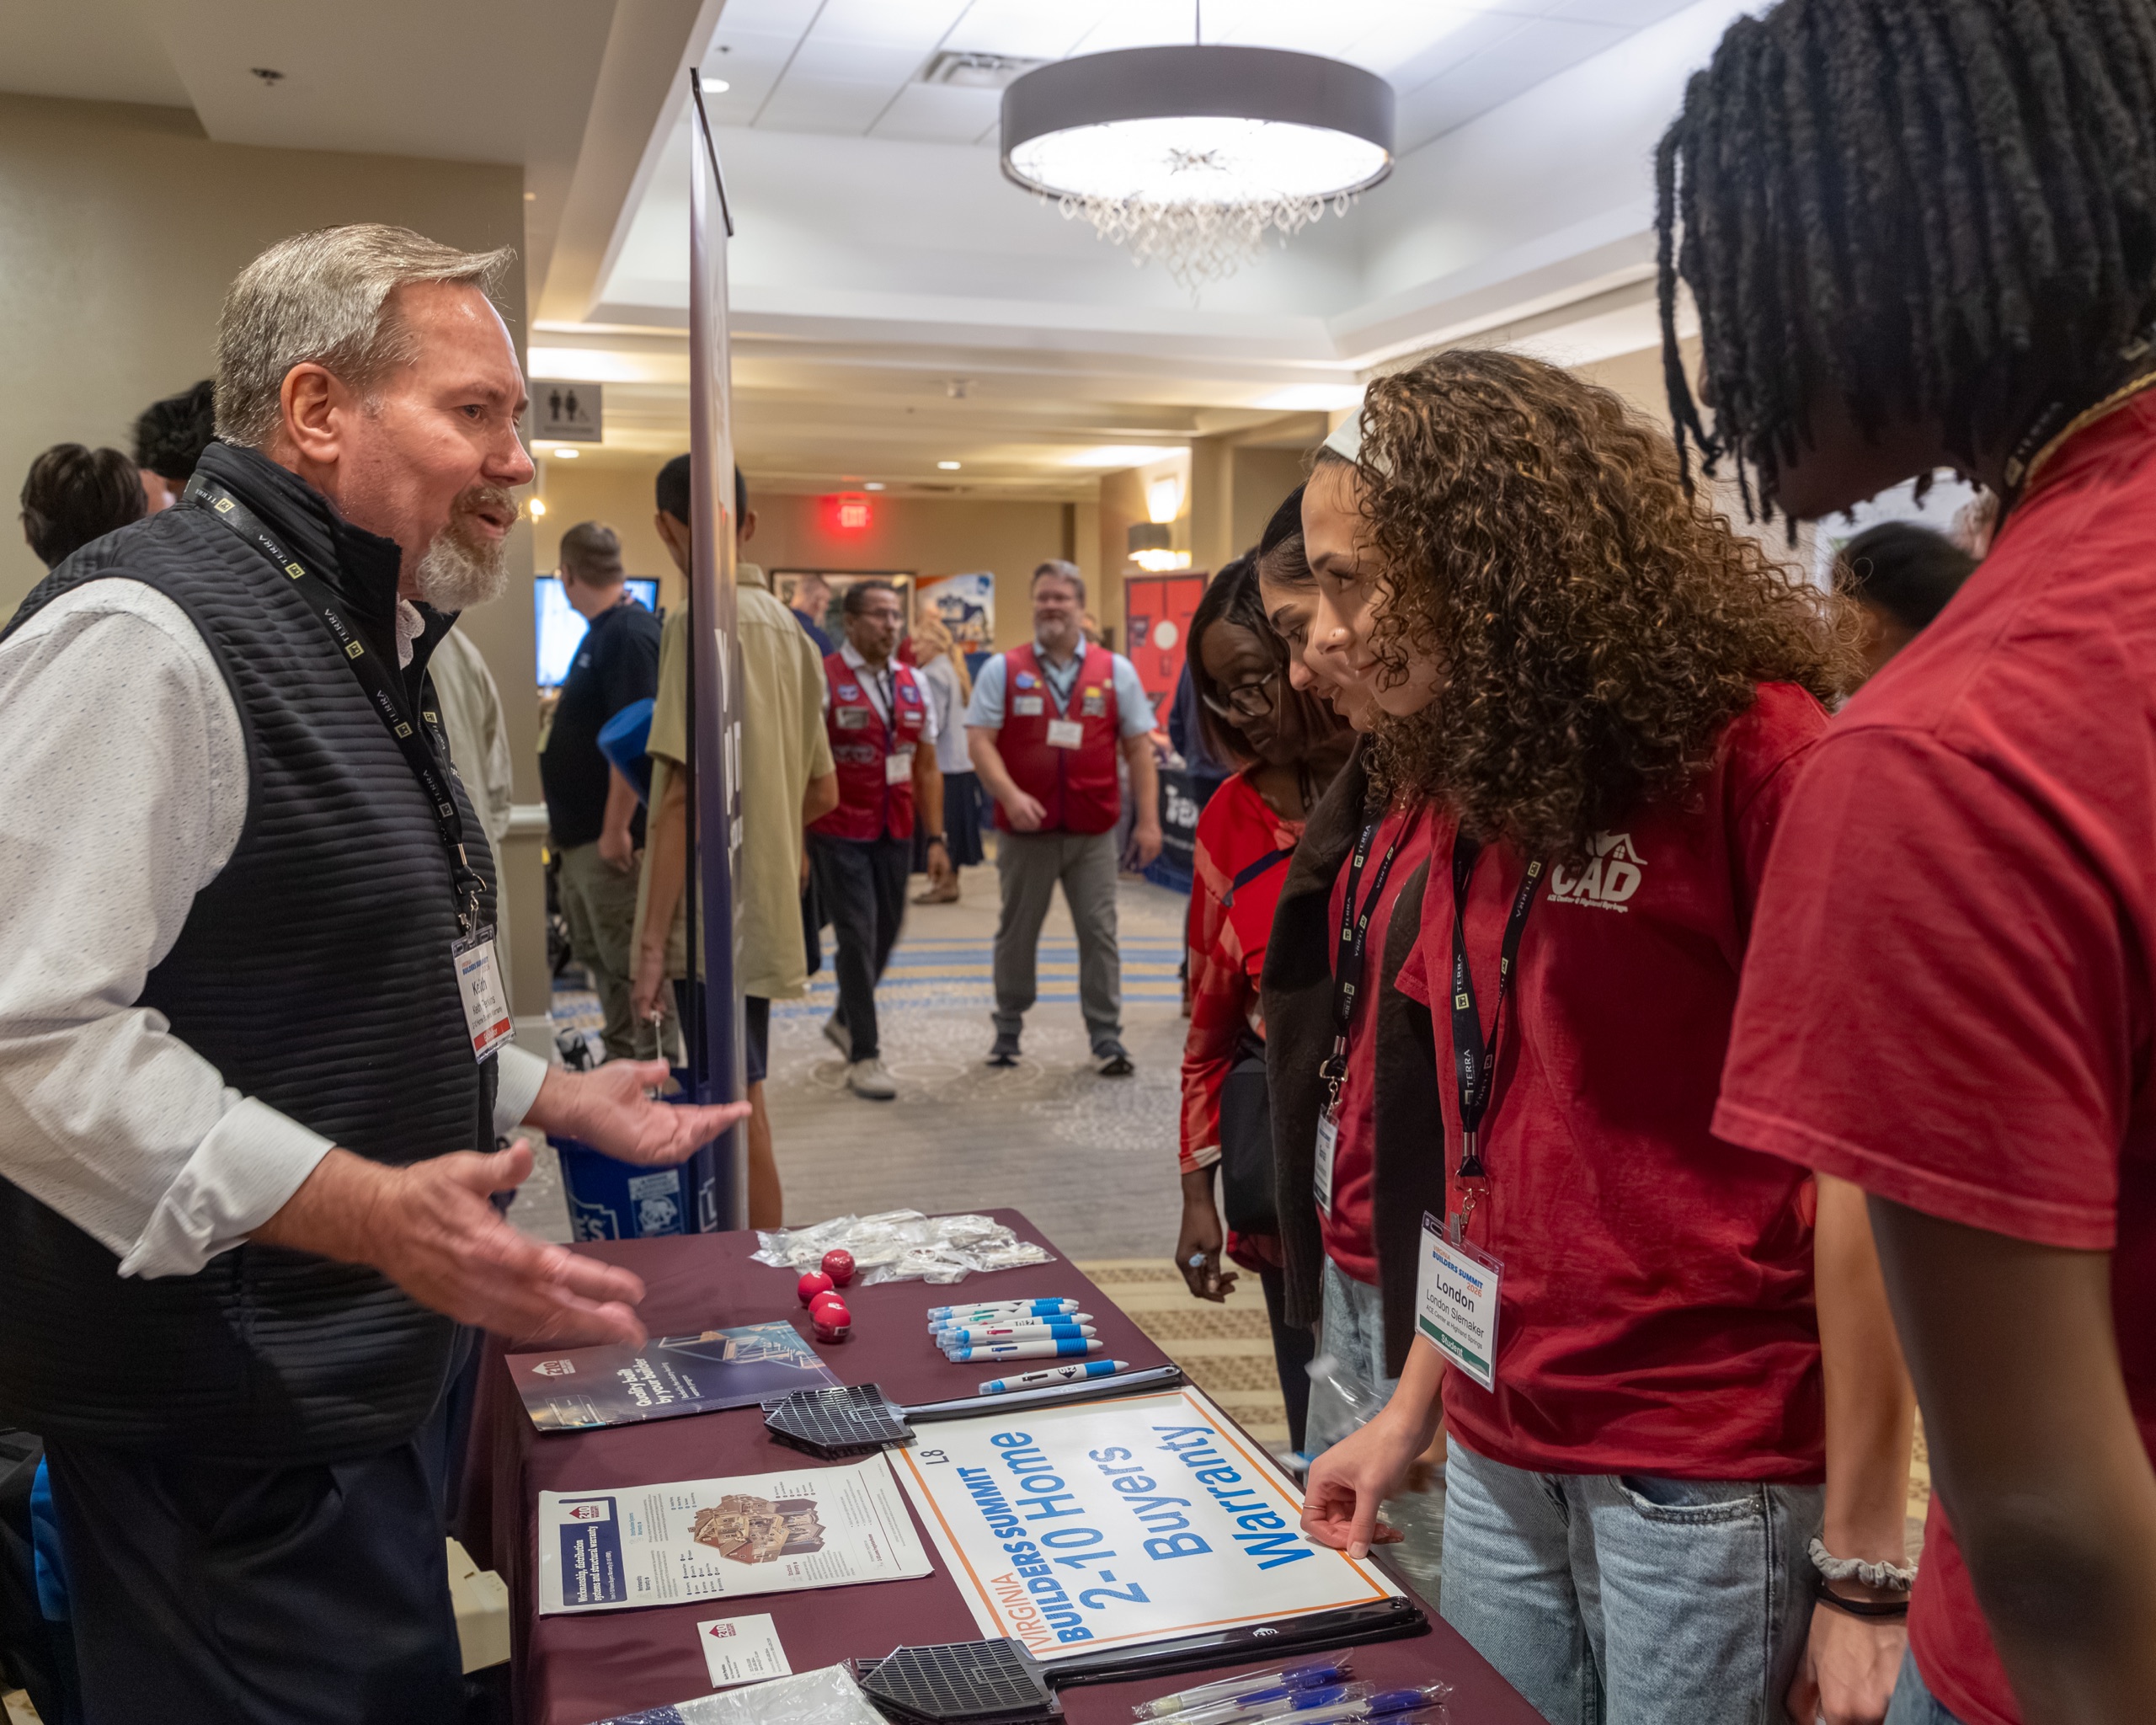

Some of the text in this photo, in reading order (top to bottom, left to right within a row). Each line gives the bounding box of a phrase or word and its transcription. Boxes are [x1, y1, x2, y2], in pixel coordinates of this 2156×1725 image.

[259, 534, 288, 566] TERRA
[324, 608, 350, 644] TERRA
[376, 690, 399, 723] TERRA
[423, 770, 442, 802] TERRA
[1358, 825, 1371, 853] TERRA
[1551, 857, 1642, 903] CAD
[472, 977, 488, 996] Keith
[1464, 1049, 1474, 1087] TERRA
[1433, 1244, 1451, 1261] VIRGINIA
[1433, 1250, 1483, 1290] BUILDERS SUMMIT
[1436, 1274, 1475, 1313] London
[1466, 1282, 1482, 1298] 2026
[1426, 1289, 1485, 1338] London Slemaker
[1426, 1304, 1434, 1315] ACE
[1433, 1311, 1447, 1324] Center
[1450, 1323, 1467, 1339] Highland
[1467, 1335, 1483, 1349] Springs
[1441, 1333, 1464, 1357] Student
[616, 1368, 652, 1406] Quality built
[632, 1358, 674, 1405] by your builder
[919, 1449, 950, 1466] L8
[1088, 1446, 1214, 1562] Buyers
[1151, 1426, 1316, 1572] Warranty
[990, 1431, 1151, 1610] 2-10 Home
[574, 1539, 588, 1602] Workmanship, distribution
[587, 1526, 604, 1600] systems and structural warranty
[956, 1467, 1095, 1643] BUILDERS SUMMIT
[990, 1572, 1052, 1649] VIRGINIA
